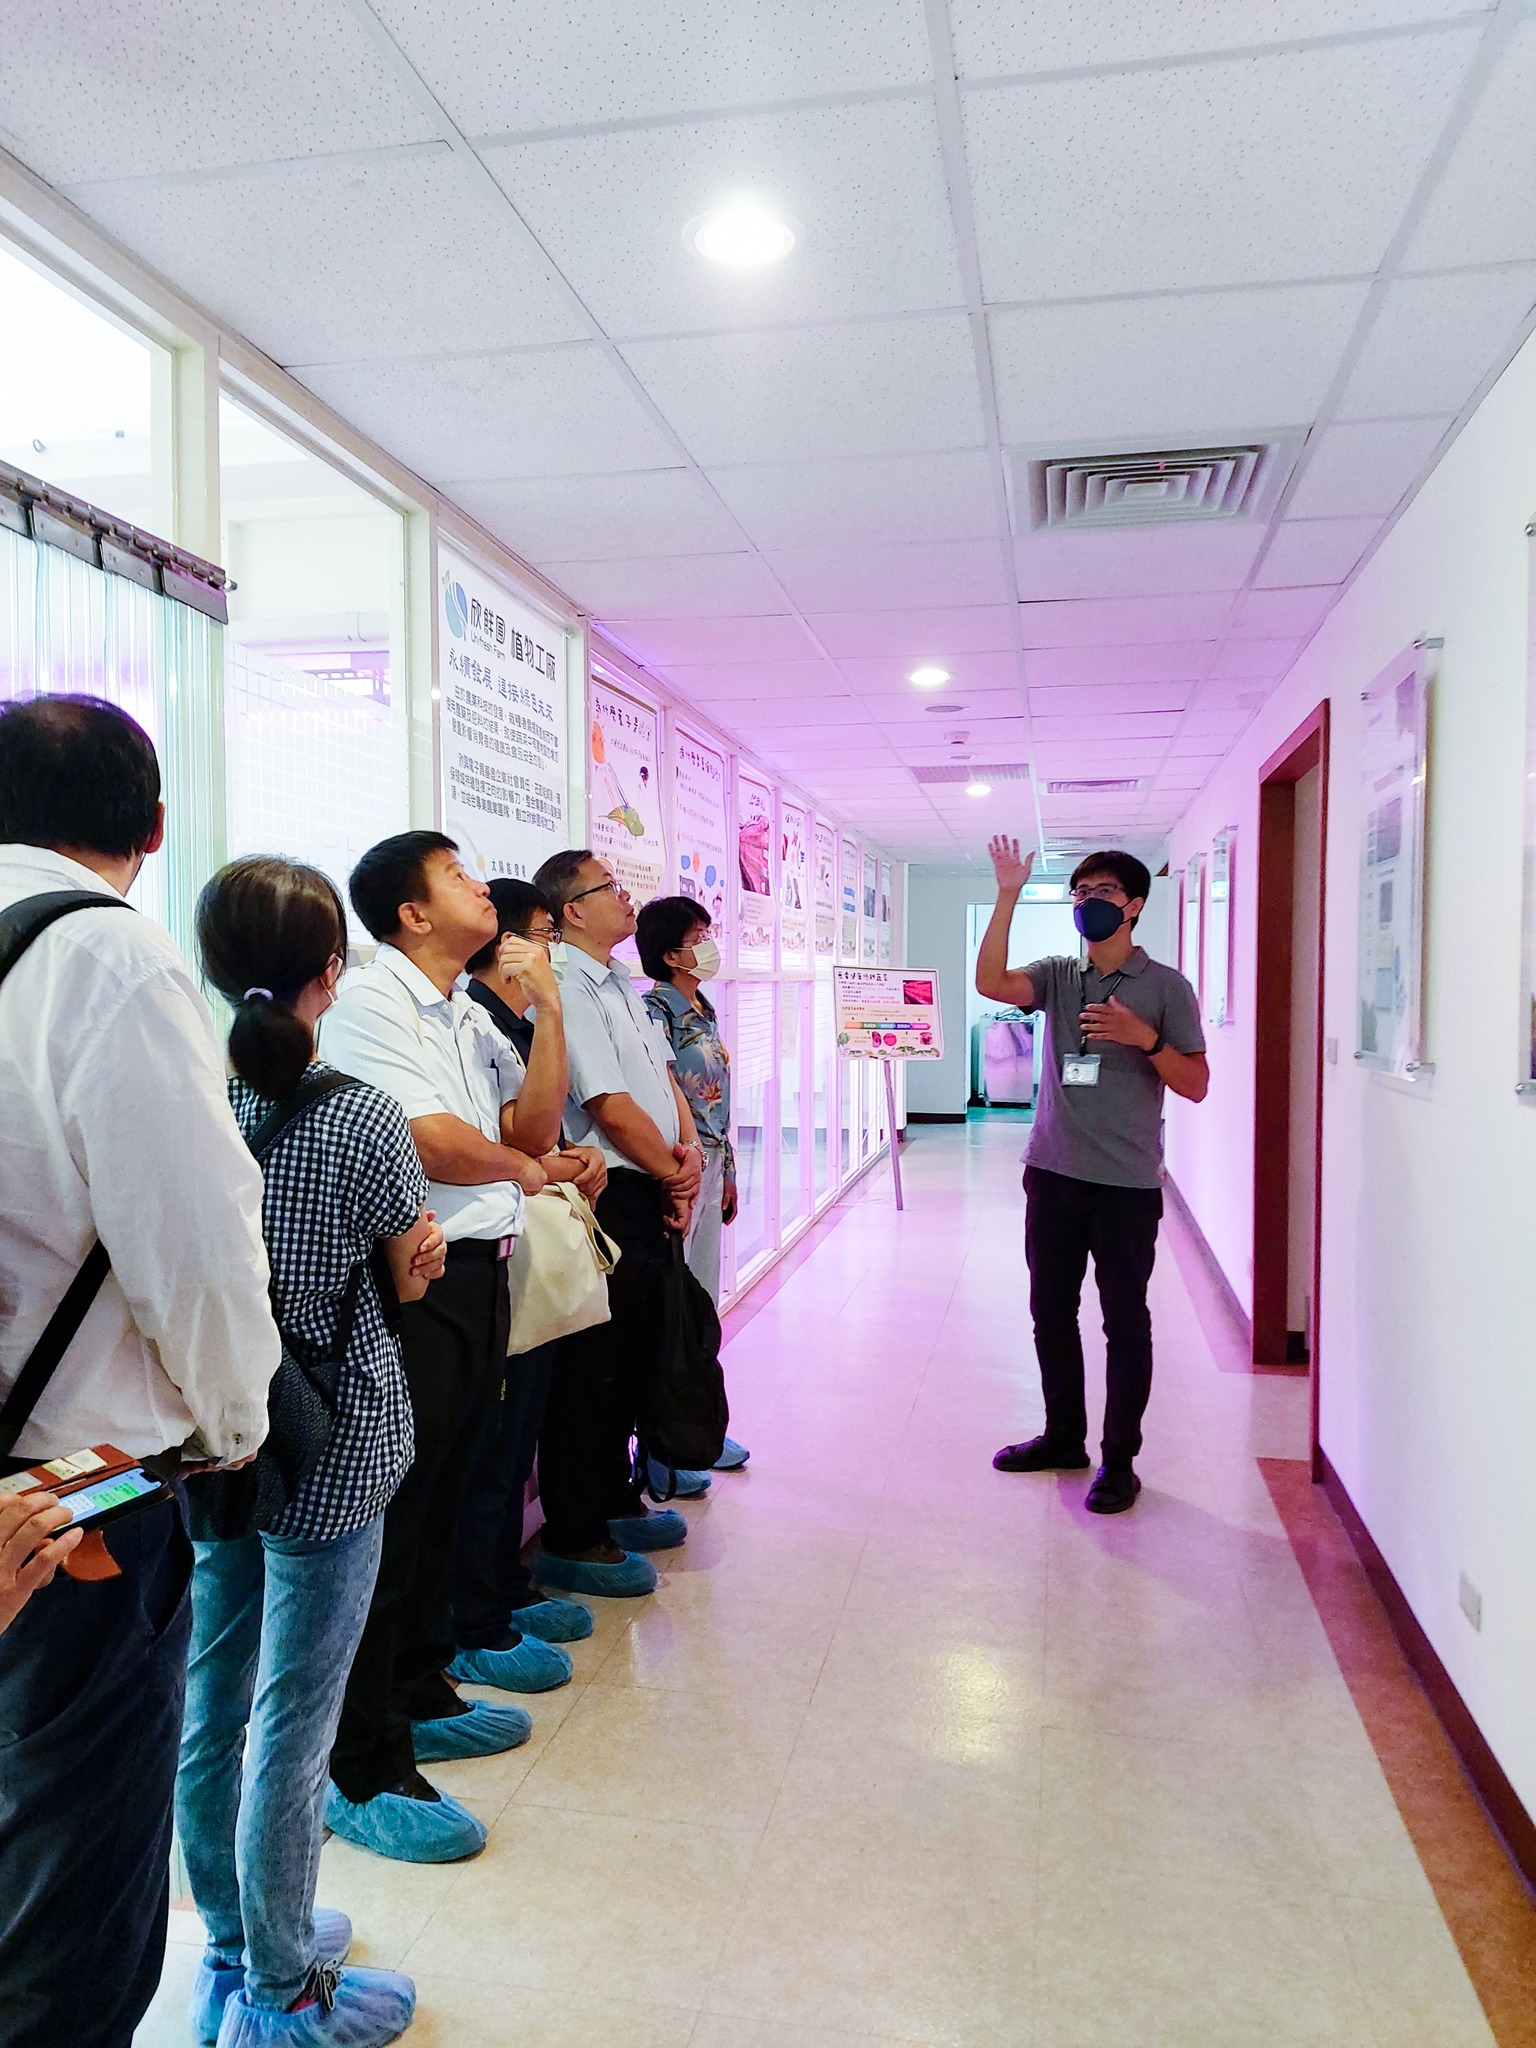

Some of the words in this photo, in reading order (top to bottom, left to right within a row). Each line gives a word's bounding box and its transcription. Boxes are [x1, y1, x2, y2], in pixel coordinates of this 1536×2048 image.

[449, 648, 492, 690] 永續發展
[511, 627, 555, 682] 植物工廠
